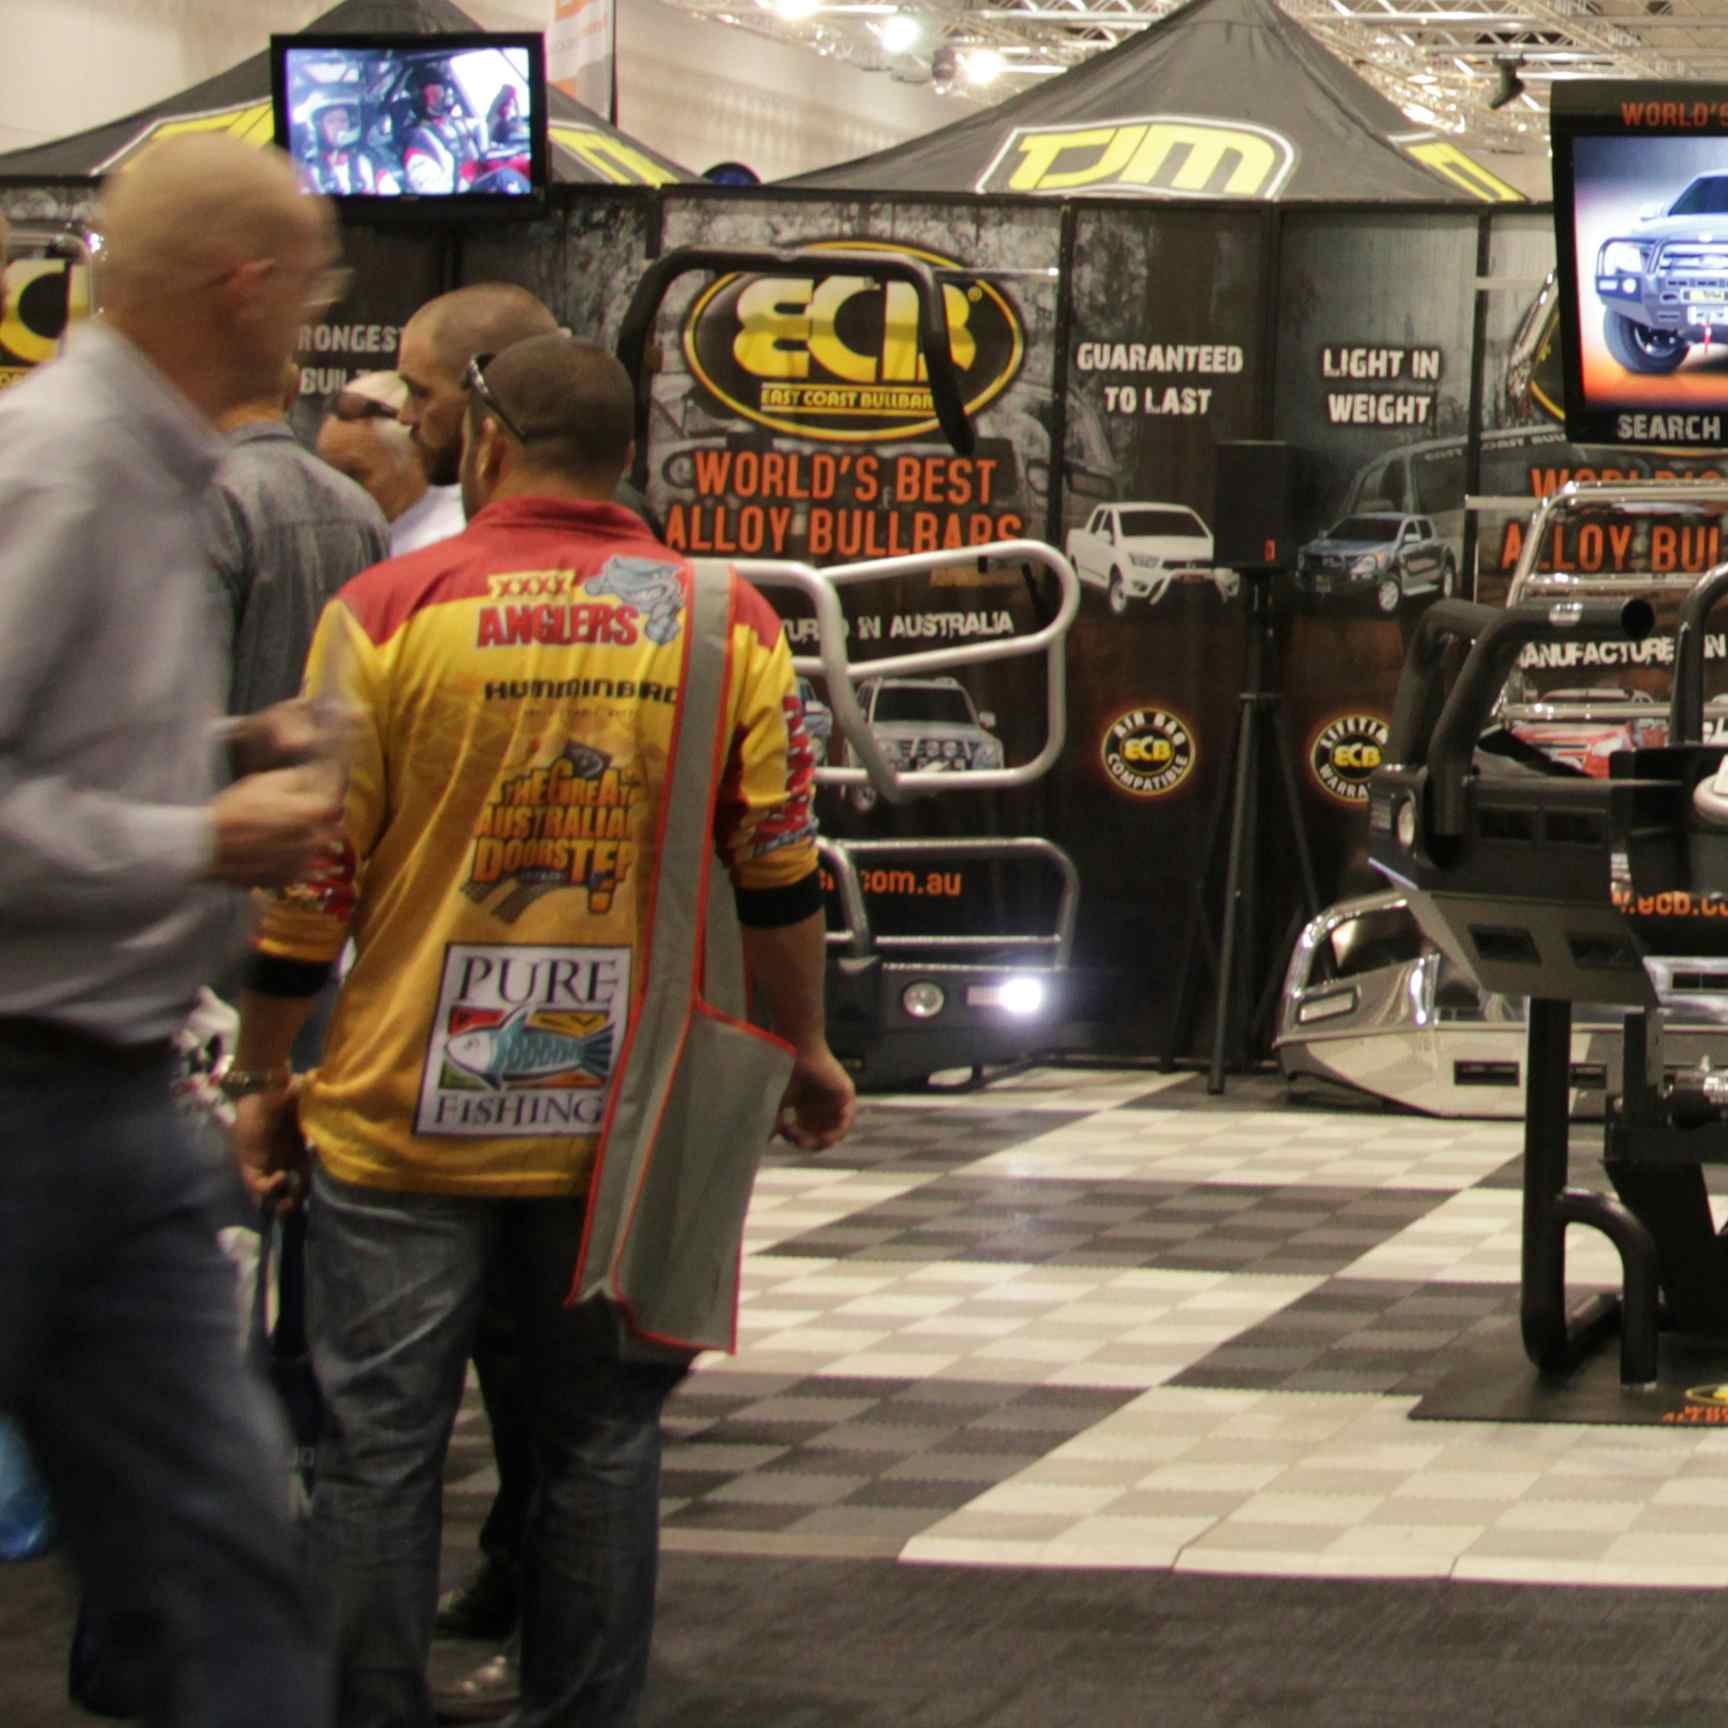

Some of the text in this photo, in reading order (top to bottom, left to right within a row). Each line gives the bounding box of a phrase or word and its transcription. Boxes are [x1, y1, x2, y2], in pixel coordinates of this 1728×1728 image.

[297, 324, 401, 352] RONGES
[734, 274, 977, 383] ECB
[1077, 343, 1244, 374] GUARANTEED
[1323, 348, 1440, 380] LIGHT IN
[803, 390, 933, 408] COAST BULLBAR
[1105, 386, 1212, 416] TO LAST
[1328, 394, 1431, 425] WEIGHT
[1616, 413, 1725, 442] SEARCH
[693, 451, 998, 506] WORLD'S BEST
[664, 503, 1024, 557] ALLOY BULLBARS
[1500, 522, 1633, 573] ALOY
[477, 603, 639, 648] ANGLERS
[857, 616, 880, 640] IN
[890, 611, 1015, 638] AUSTRALIA
[1519, 636, 1675, 669] ANUFACTURE
[1703, 632, 1726, 658] IN
[1124, 736, 1173, 761] ECB
[1333, 742, 1381, 768] ECB
[1108, 753, 1188, 790] COMPATIBLE
[1319, 763, 1370, 797] WARRA
[458, 955, 619, 1005] PURE
[434, 1091, 602, 1126] FISHING
